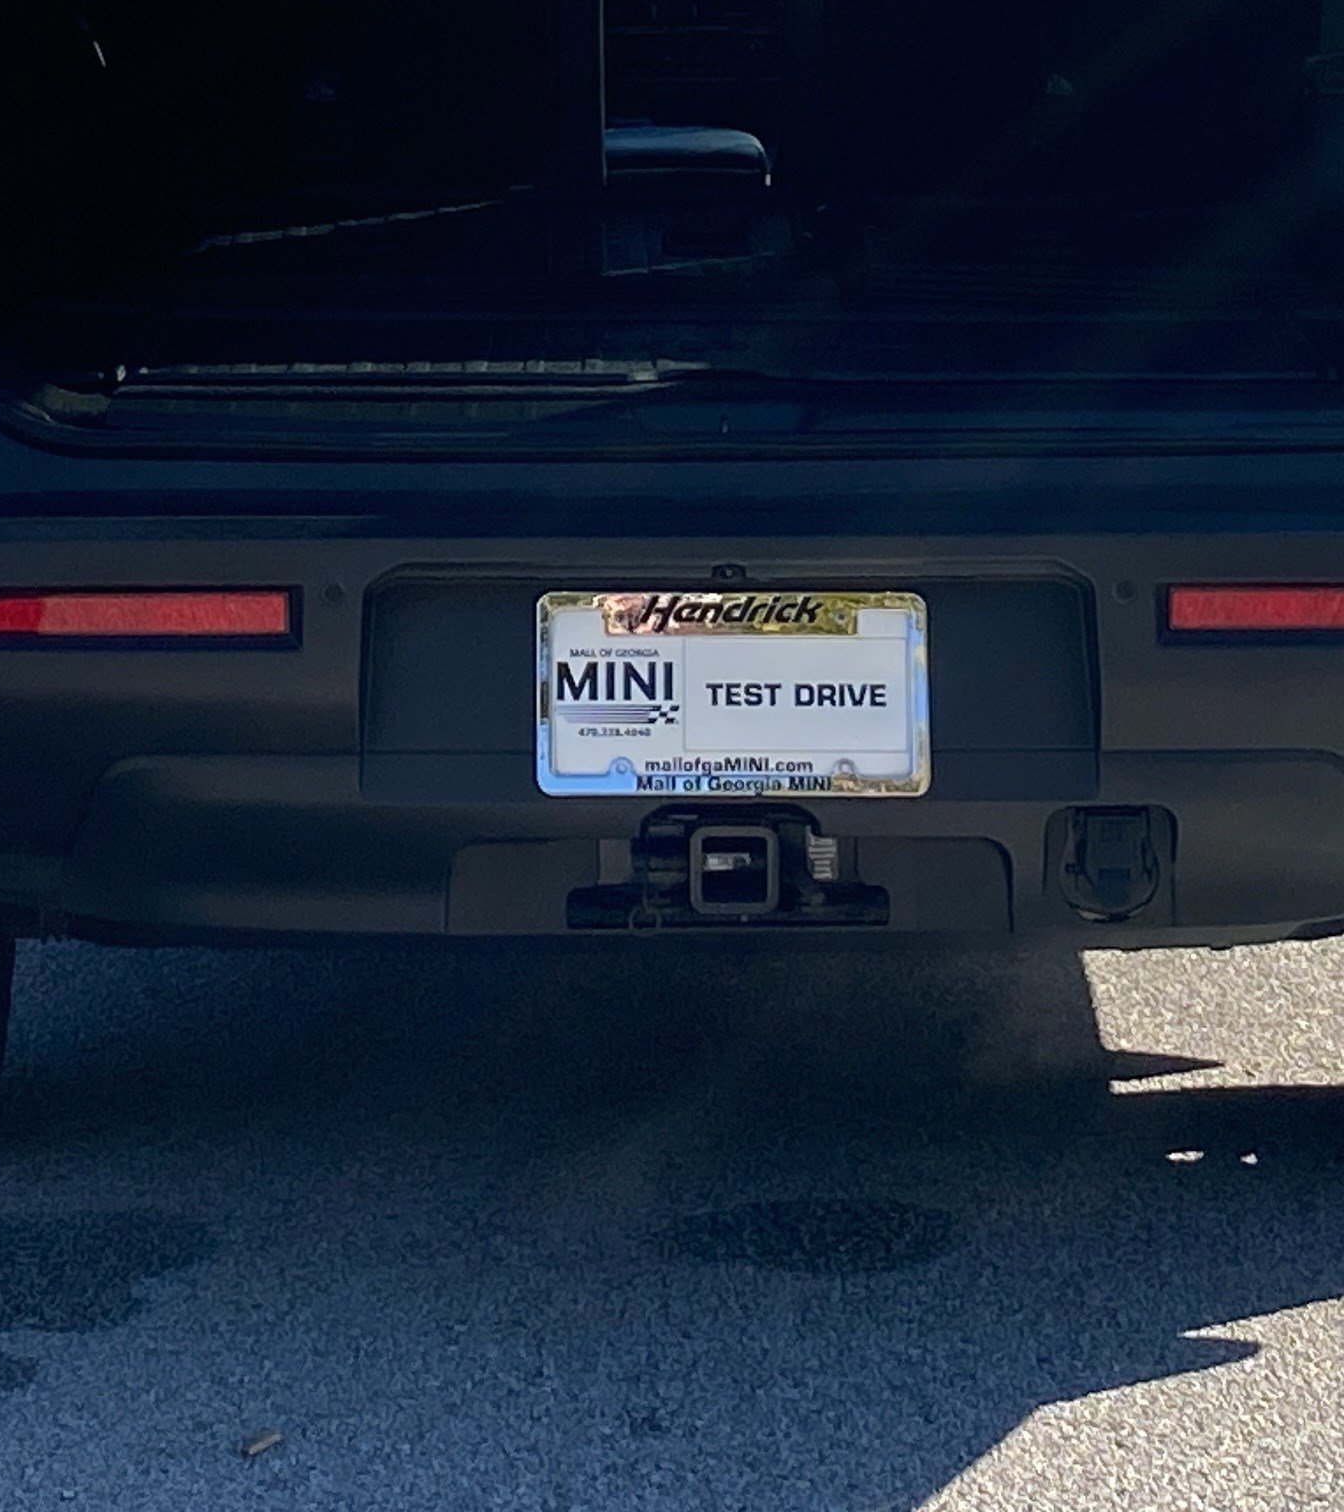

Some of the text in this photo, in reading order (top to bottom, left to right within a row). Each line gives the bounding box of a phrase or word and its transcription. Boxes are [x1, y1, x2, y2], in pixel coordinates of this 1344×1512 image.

[639, 595, 824, 633] Hendrick
[556, 661, 674, 701] MINI
[705, 682, 888, 707] TEST DRIVE
[644, 756, 814, 775] mallofgaMINI.com
[636, 775, 832, 793] Mall of Georgia MINI
